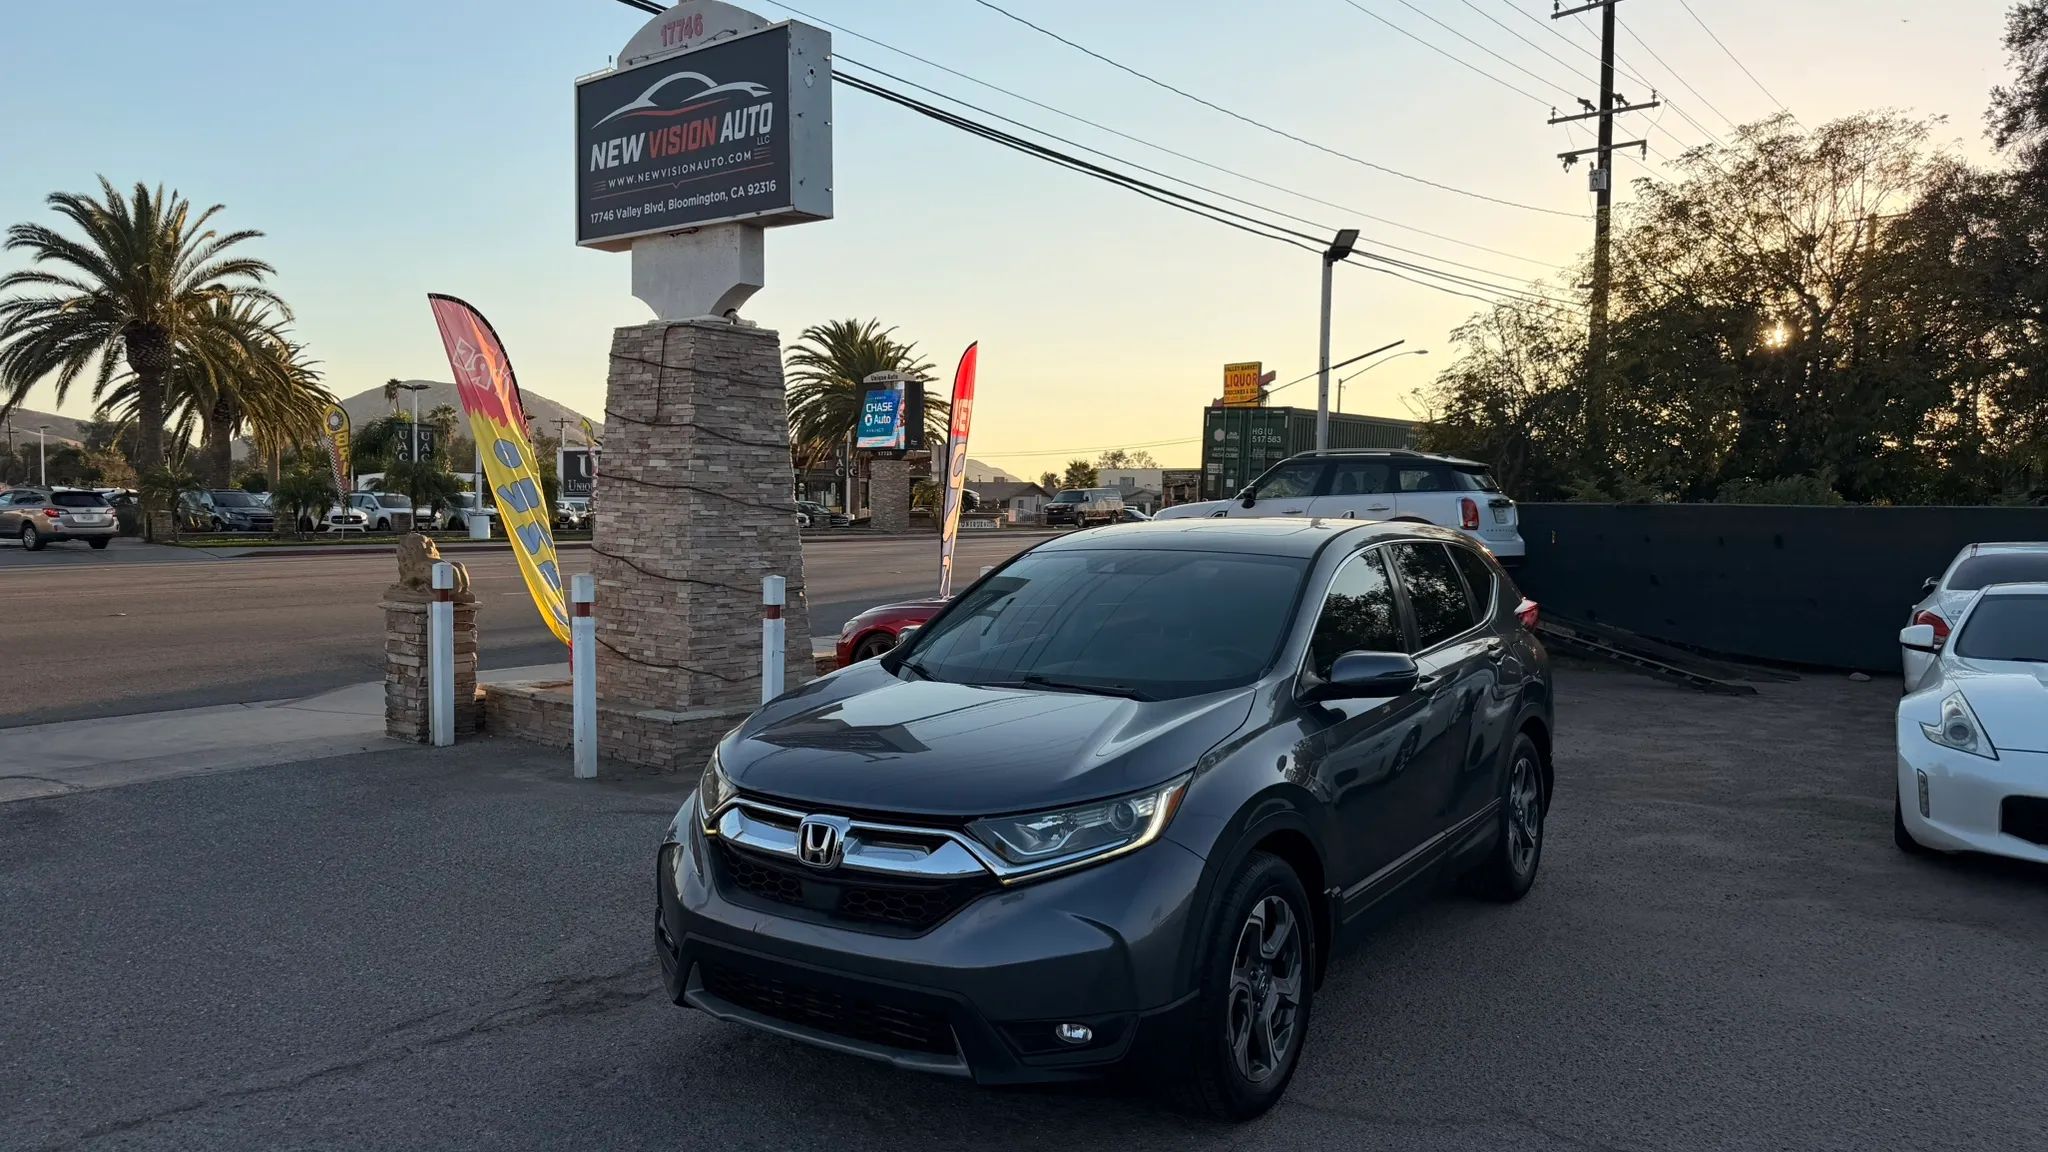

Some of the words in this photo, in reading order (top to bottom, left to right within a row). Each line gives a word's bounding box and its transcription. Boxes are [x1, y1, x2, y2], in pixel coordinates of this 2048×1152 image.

[660, 14, 704, 47] 17746
[590, 132, 645, 172] NEW
[649, 116, 717, 159] VISION
[720, 102, 773, 144] AUTO
[757, 135, 770, 146] LLC
[608, 150, 752, 189] WWW.NEWVISIONAUTO.COM
[591, 212, 614, 224] 17746
[616, 205, 642, 220] Valley
[644, 201, 666, 216] Blvd,
[668, 191, 729, 210] Bloomington,
[730, 185, 745, 198] CA
[747, 180, 777, 195] 92316
[1225, 373, 1259, 387] LIQUOR
[866, 401, 893, 413] CHASE
[873, 414, 892, 425] Auto
[568, 479, 592, 491] UNIQ
